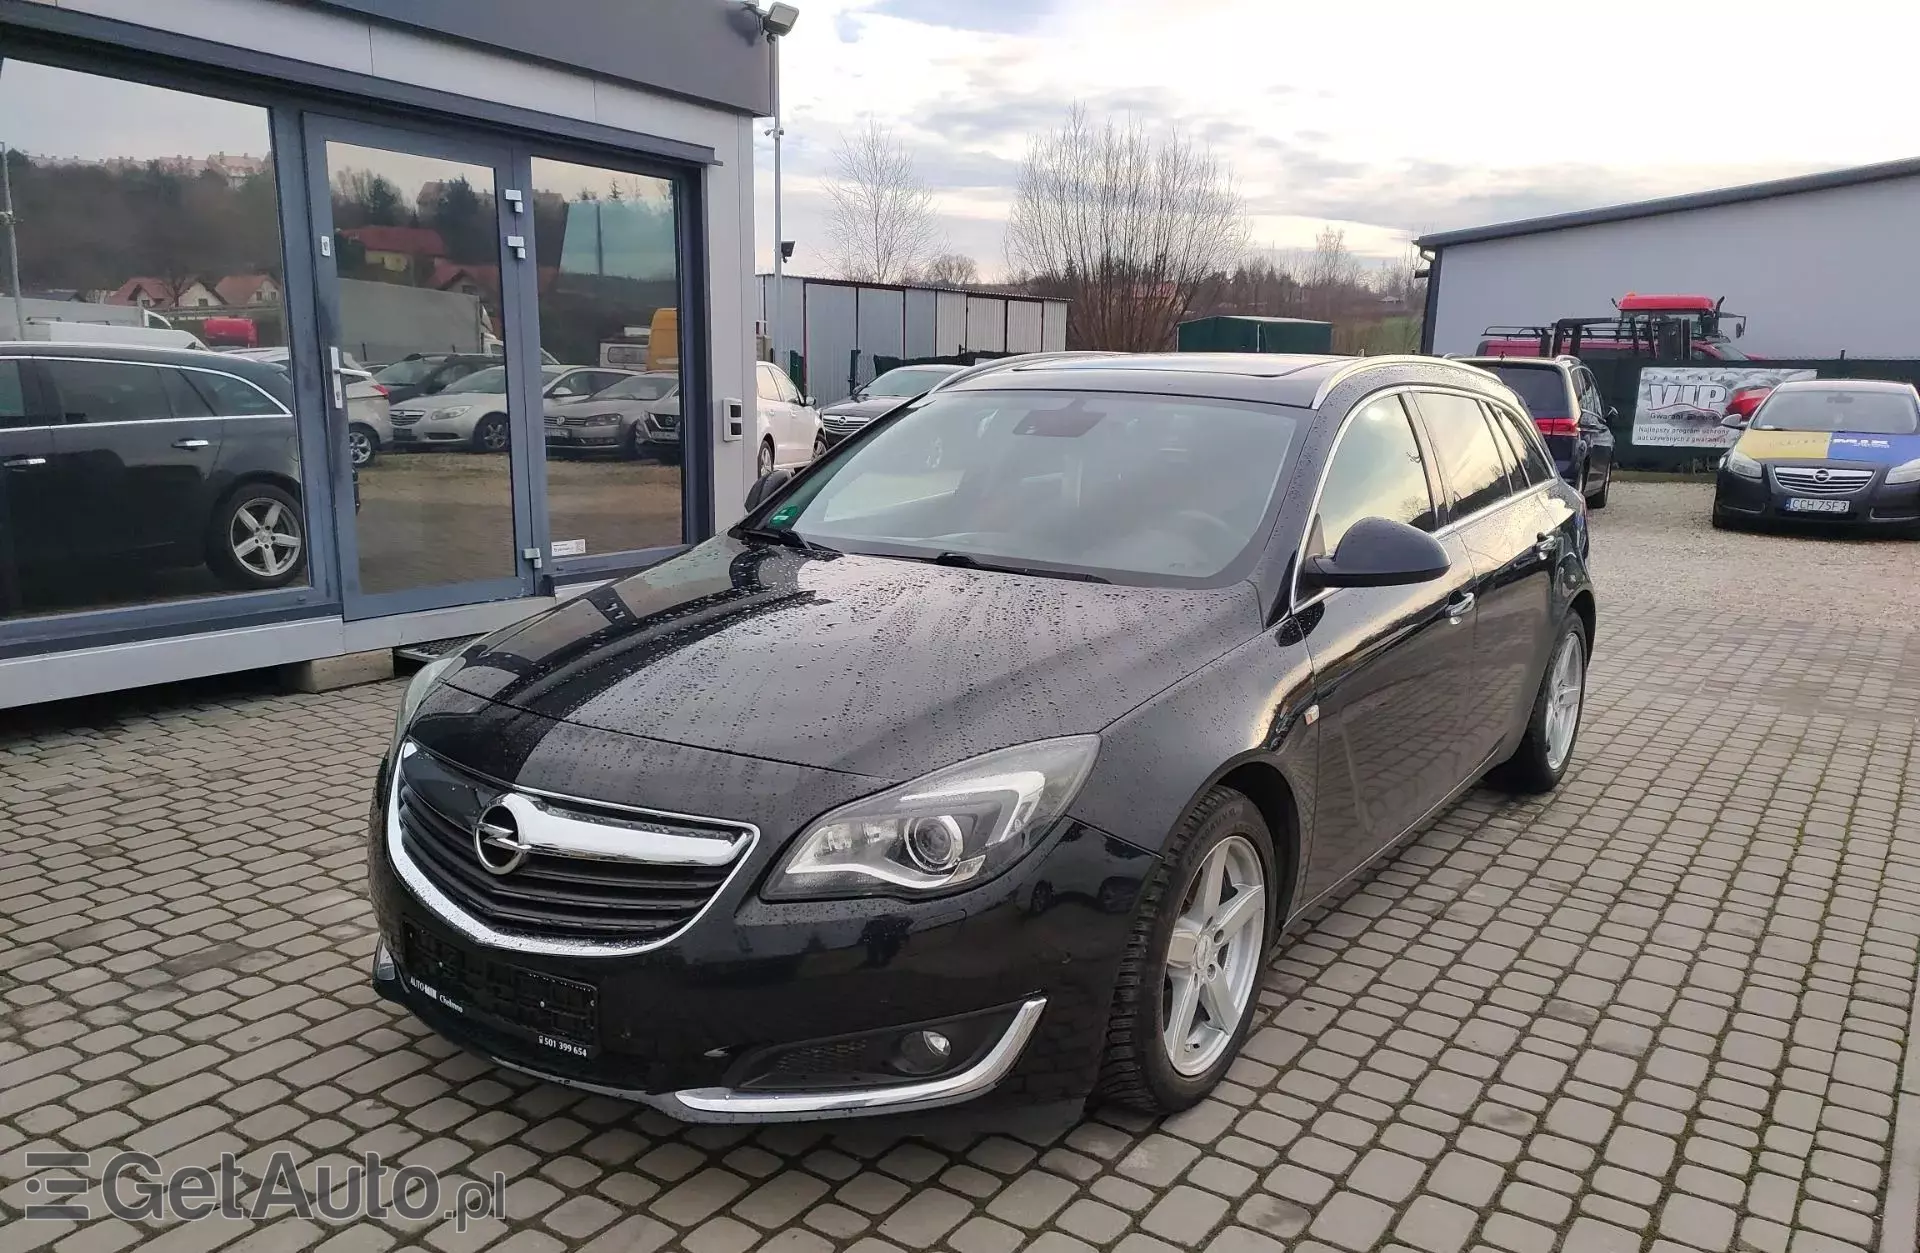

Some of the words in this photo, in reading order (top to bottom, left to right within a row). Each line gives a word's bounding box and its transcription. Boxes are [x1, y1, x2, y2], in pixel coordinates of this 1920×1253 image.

[1648, 383, 1727, 409] VIP
[1792, 499, 1815, 510] CCH
[544, 1037, 556, 1048] 501
[559, 1041, 572, 1053] 399
[573, 1046, 587, 1057] 654
